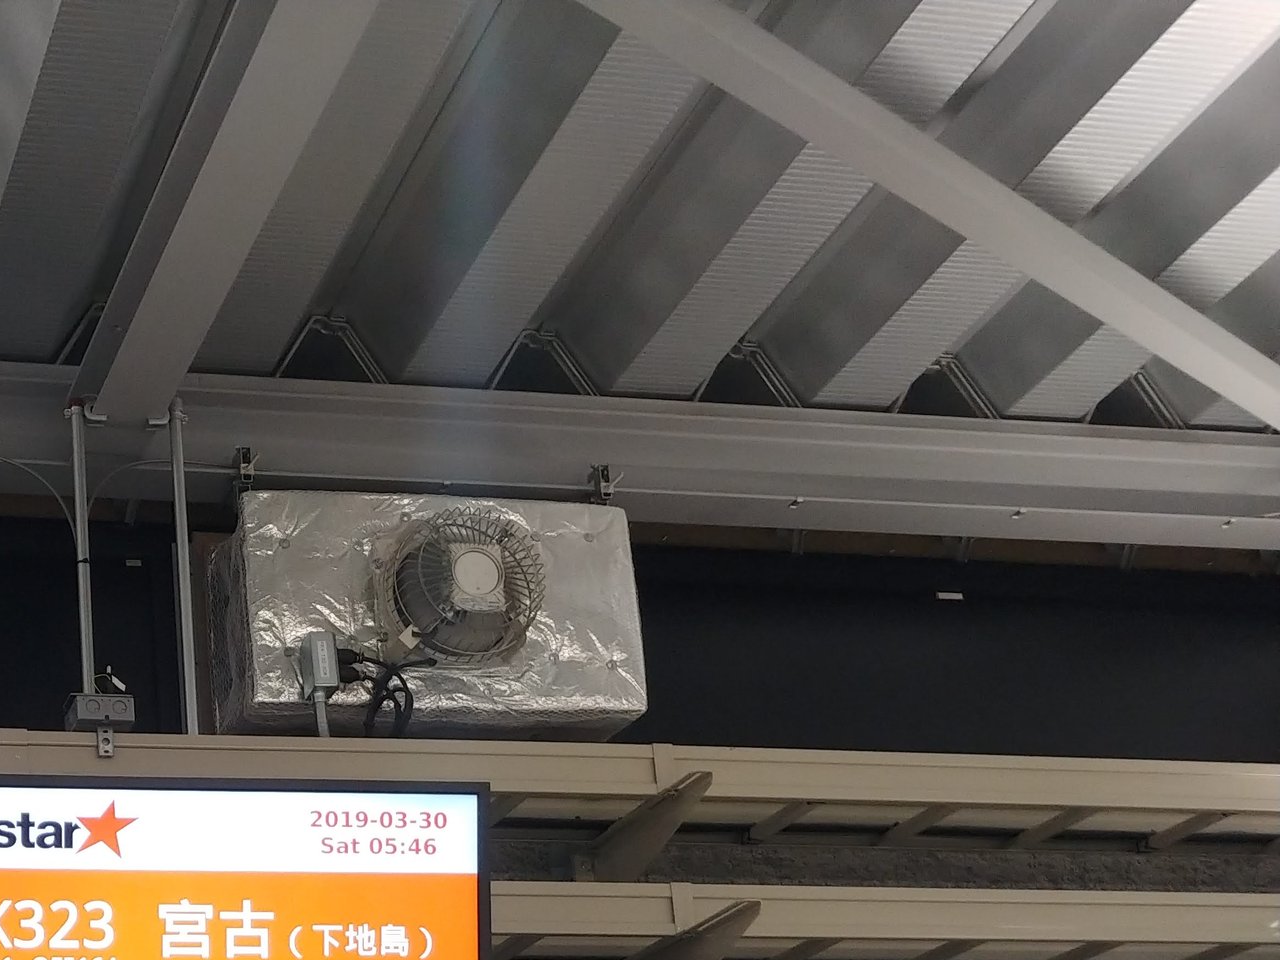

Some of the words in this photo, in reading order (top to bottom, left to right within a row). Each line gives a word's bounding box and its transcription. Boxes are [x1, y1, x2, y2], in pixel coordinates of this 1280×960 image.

[310, 810, 448, 829] 2019-03-30
[321, 837, 360, 855] Sat
[369, 838, 438, 856] 05:46
[158, 898, 276, 959] 宮古
